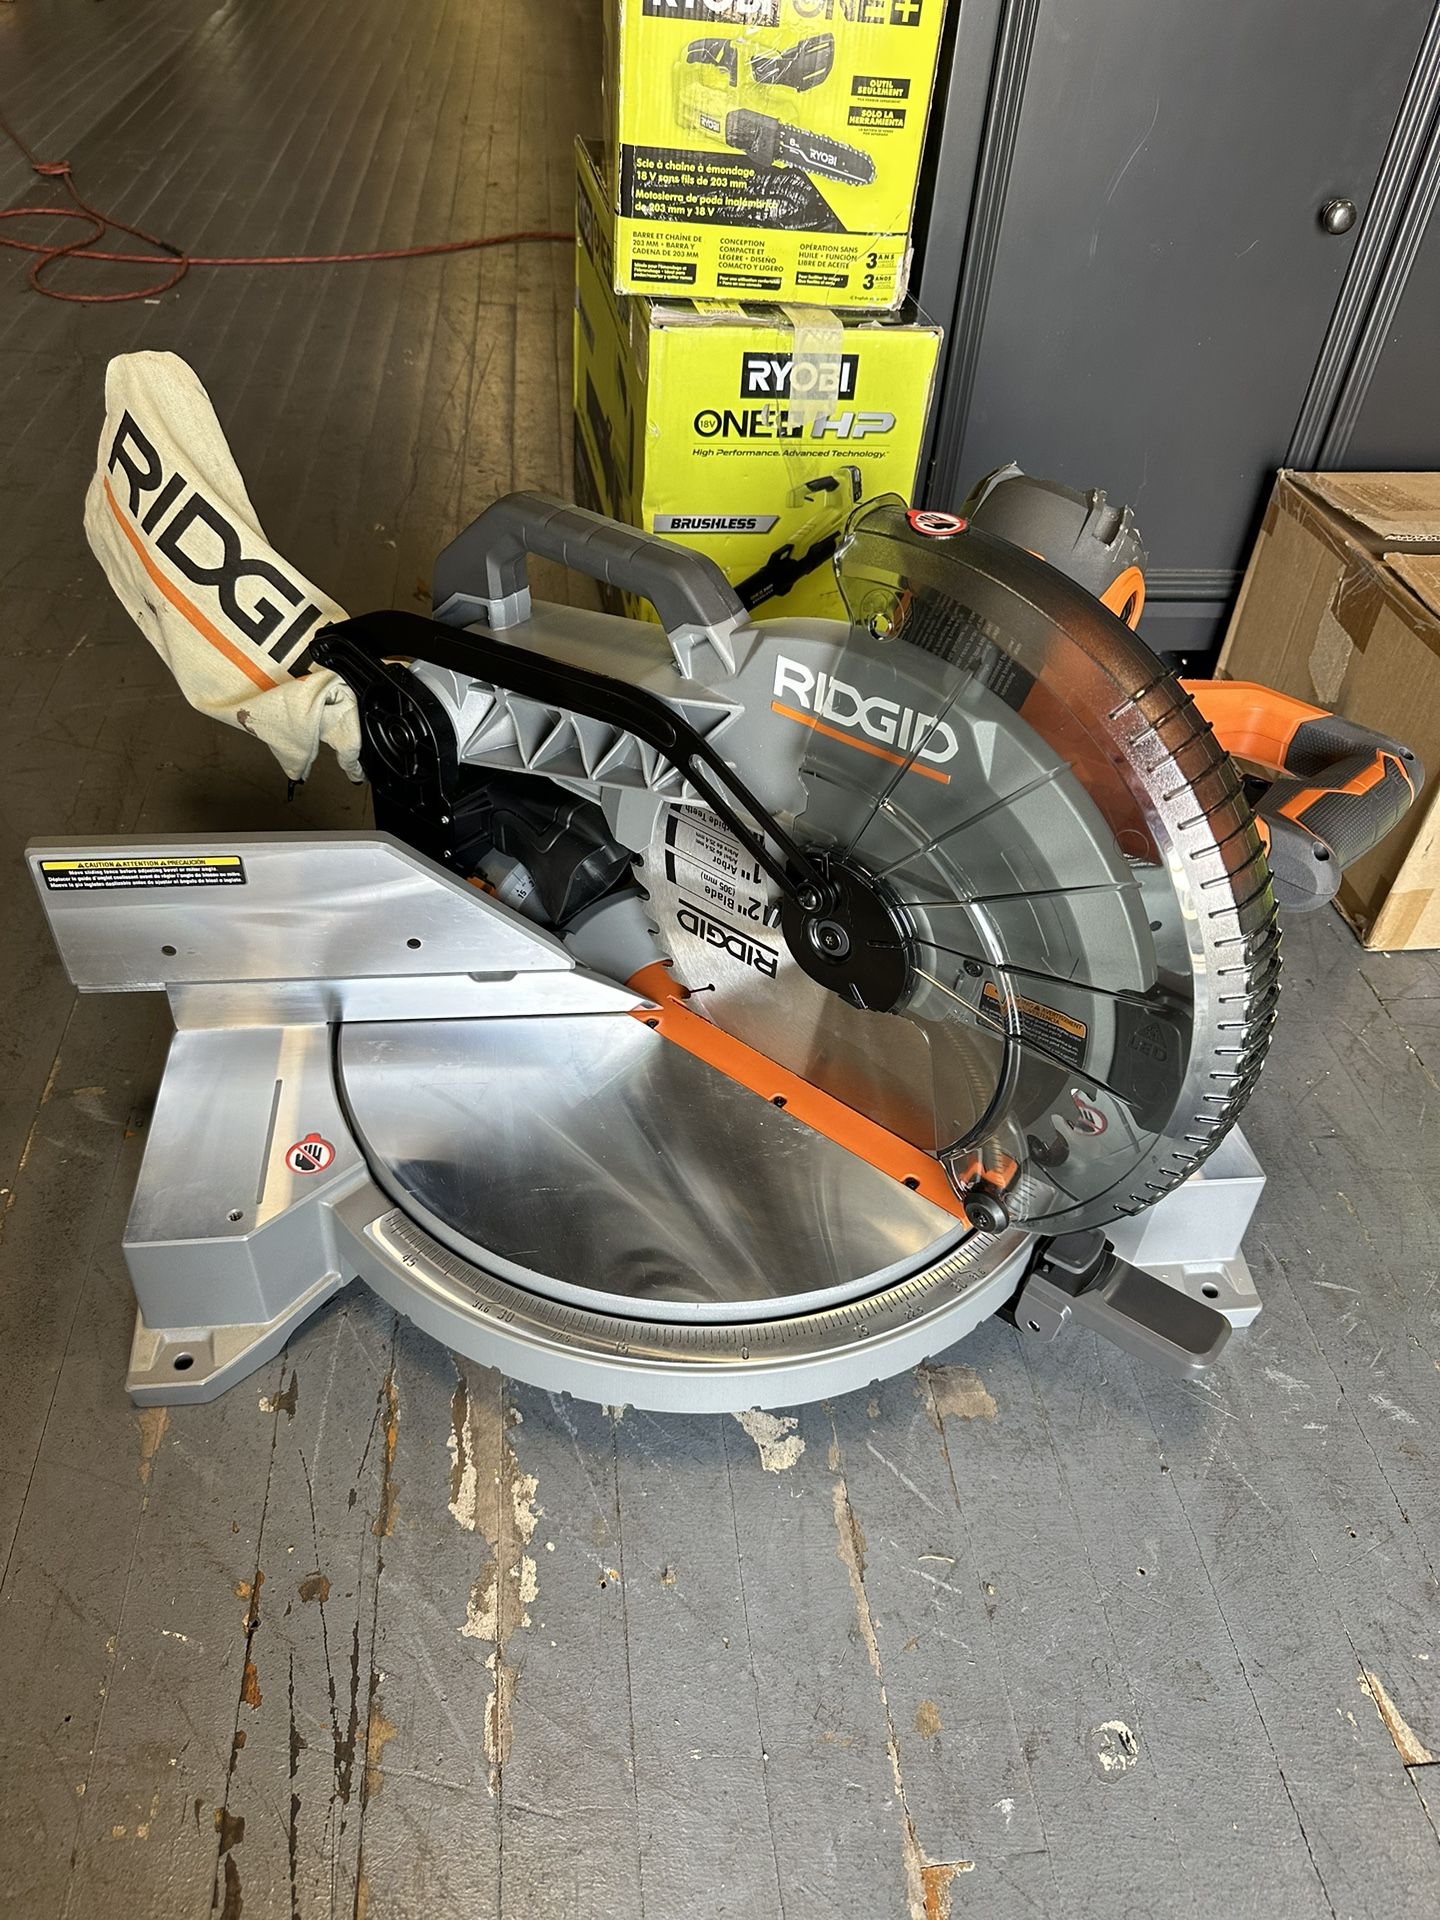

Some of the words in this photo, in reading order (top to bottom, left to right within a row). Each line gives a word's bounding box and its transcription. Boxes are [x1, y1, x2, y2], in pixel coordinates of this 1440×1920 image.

[858, 86, 904, 96] SEULEMENT
[870, 80, 893, 88] OUTIL
[701, 117, 720, 132] RYOBI
[849, 116, 904, 126] HERRAMIENTA
[810, 148, 837, 166] RYOBI
[636, 158, 654, 168] Scie
[657, 160, 663, 169] à
[698, 163, 704, 173] à
[706, 164, 755, 177] émondage
[636, 170, 647, 180] 18
[649, 172, 657, 181] V
[658, 174, 680, 183] sans
[681, 174, 695, 185] fils
[696, 176, 708, 186] de
[710, 178, 727, 187] 203
[635, 189, 683, 202] Motosierra
[686, 193, 697, 203] de
[700, 194, 722, 205] poda
[635, 201, 647, 212] de
[649, 203, 666, 213] 203
[668, 206, 685, 214] mm
[687, 208, 693, 217] y
[695, 206, 705, 216] 18
[708, 208, 715, 216] V
[720, 238, 765, 247] CONCEPTION
[720, 246, 755, 254] COMPACTE
[800, 243, 838, 252] OPÉRATION
[719, 262, 752, 270] COMACTO
[866, 253, 877, 269] 3
[863, 274, 874, 290] 3
[748, 360, 850, 392] RYOBI
[700, 420, 716, 428] 18V
[811, 412, 896, 439] HP
[692, 449, 714, 457] High
[717, 449, 780, 457] Performance.
[783, 449, 829, 457] Advanced
[671, 518, 757, 529] BRUSHLESS
[108, 410, 334, 679] RIDGI
[773, 654, 959, 763] RIDGID
[686, 805, 706, 822] Teeth
[713, 856, 737, 874] Arbor
[701, 872, 718, 886] mm)
[741, 863, 761, 884] 1"
[518, 890, 527, 899] 15
[719, 882, 735, 896] (305
[705, 885, 734, 910] Blade
[677, 910, 778, 979] RIDGID
[401, 1253, 418, 1267] 45
[472, 1300, 490, 1314] 31.6
[496, 1309, 515, 1323] 30
[741, 1346, 749, 1360] 0
[853, 1324, 870, 1338] 15
[951, 1278, 968, 1293] 30
